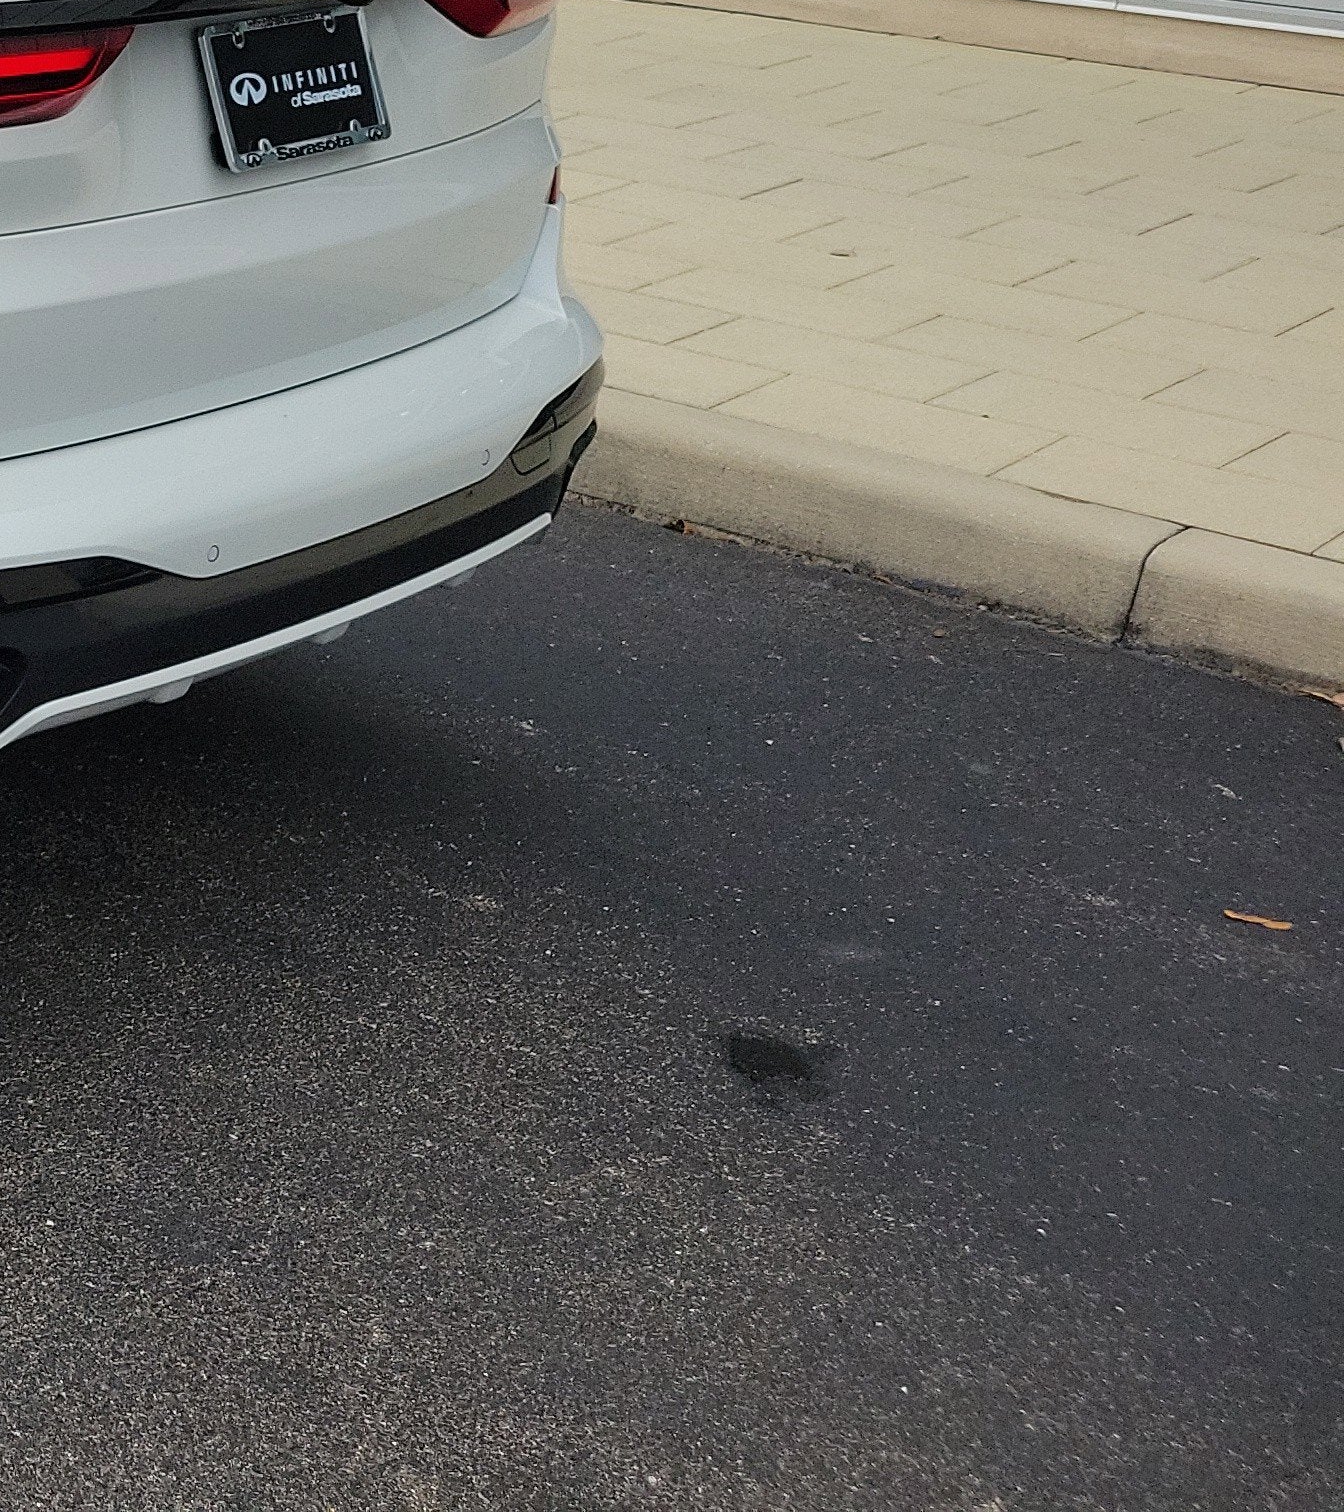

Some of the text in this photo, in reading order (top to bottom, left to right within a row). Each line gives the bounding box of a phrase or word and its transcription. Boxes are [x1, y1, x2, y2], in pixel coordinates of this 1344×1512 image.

[271, 61, 358, 93] INFINITI
[302, 83, 362, 106] Sarasota
[276, 134, 355, 161] Sarasota
